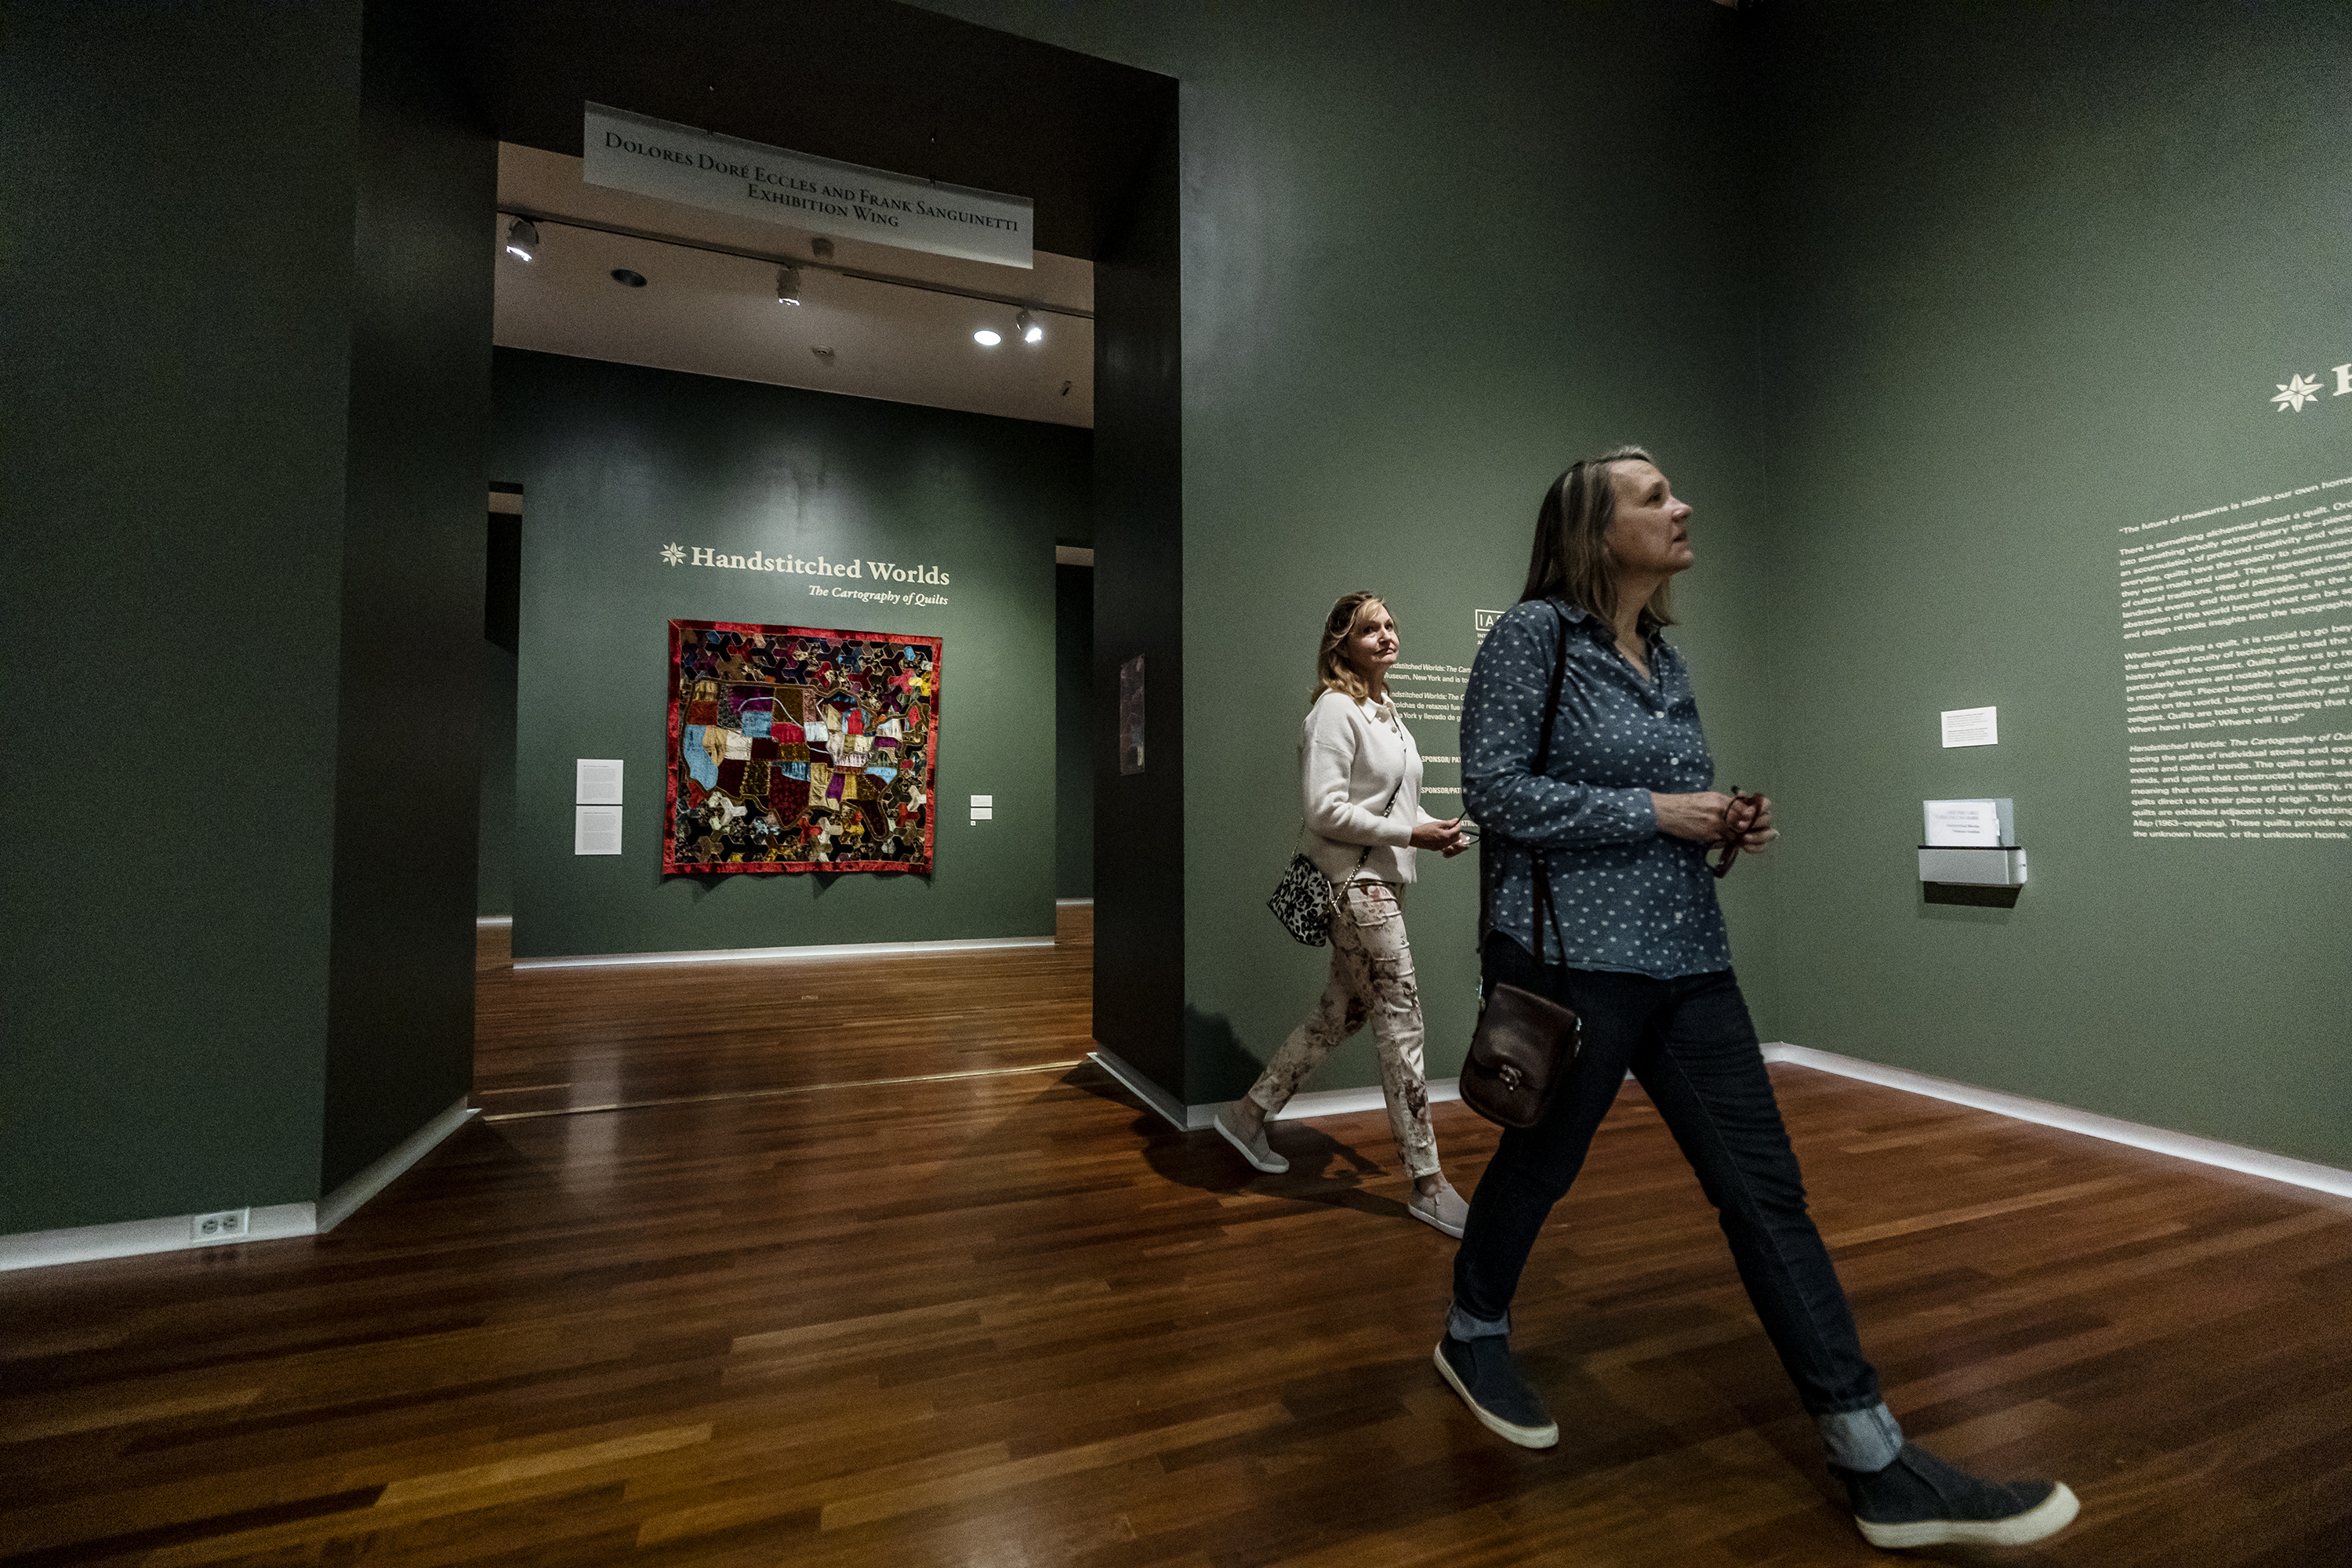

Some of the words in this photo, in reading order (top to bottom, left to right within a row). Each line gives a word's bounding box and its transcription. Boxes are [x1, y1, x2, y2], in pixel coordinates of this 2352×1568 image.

[2169, 515, 2180, 524] of
[691, 546, 862, 579] Handstitched
[866, 561, 950, 586] Worlds
[808, 585, 829, 597] The
[831, 587, 900, 604] Cartography
[902, 592, 916, 606] of
[915, 593, 949, 607] Quilts
[2172, 656, 2190, 665] and
[2214, 673, 2234, 682] and
[2275, 666, 2317, 675] women
[2318, 662, 2331, 671] of
[2278, 678, 2308, 688] quilts
[2328, 685, 2350, 694] and
[2318, 733, 2332, 742] of
[2307, 746, 2328, 754] and
[2276, 760, 2306, 768] quilts
[2265, 795, 2276, 804] of
